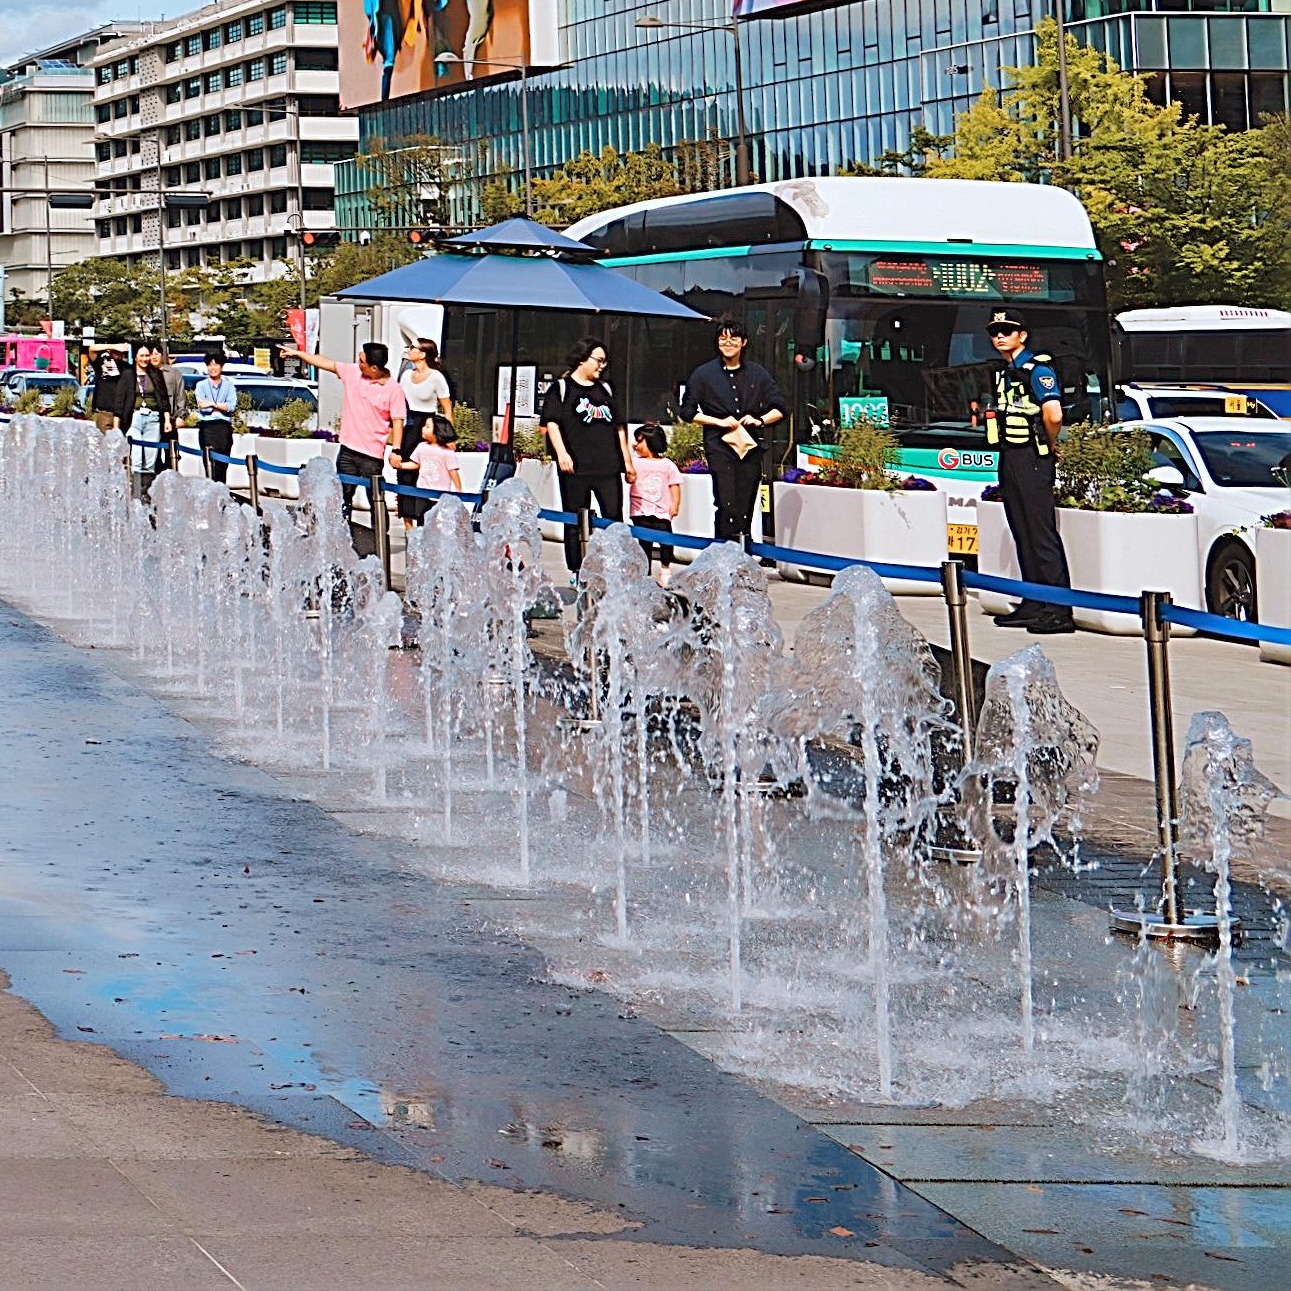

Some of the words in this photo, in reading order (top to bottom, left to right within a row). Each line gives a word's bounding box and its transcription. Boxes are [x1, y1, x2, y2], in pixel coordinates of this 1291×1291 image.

[939, 263, 989, 292] 1002
[962, 453, 994, 466] BUS
[948, 496, 977, 507] MA
